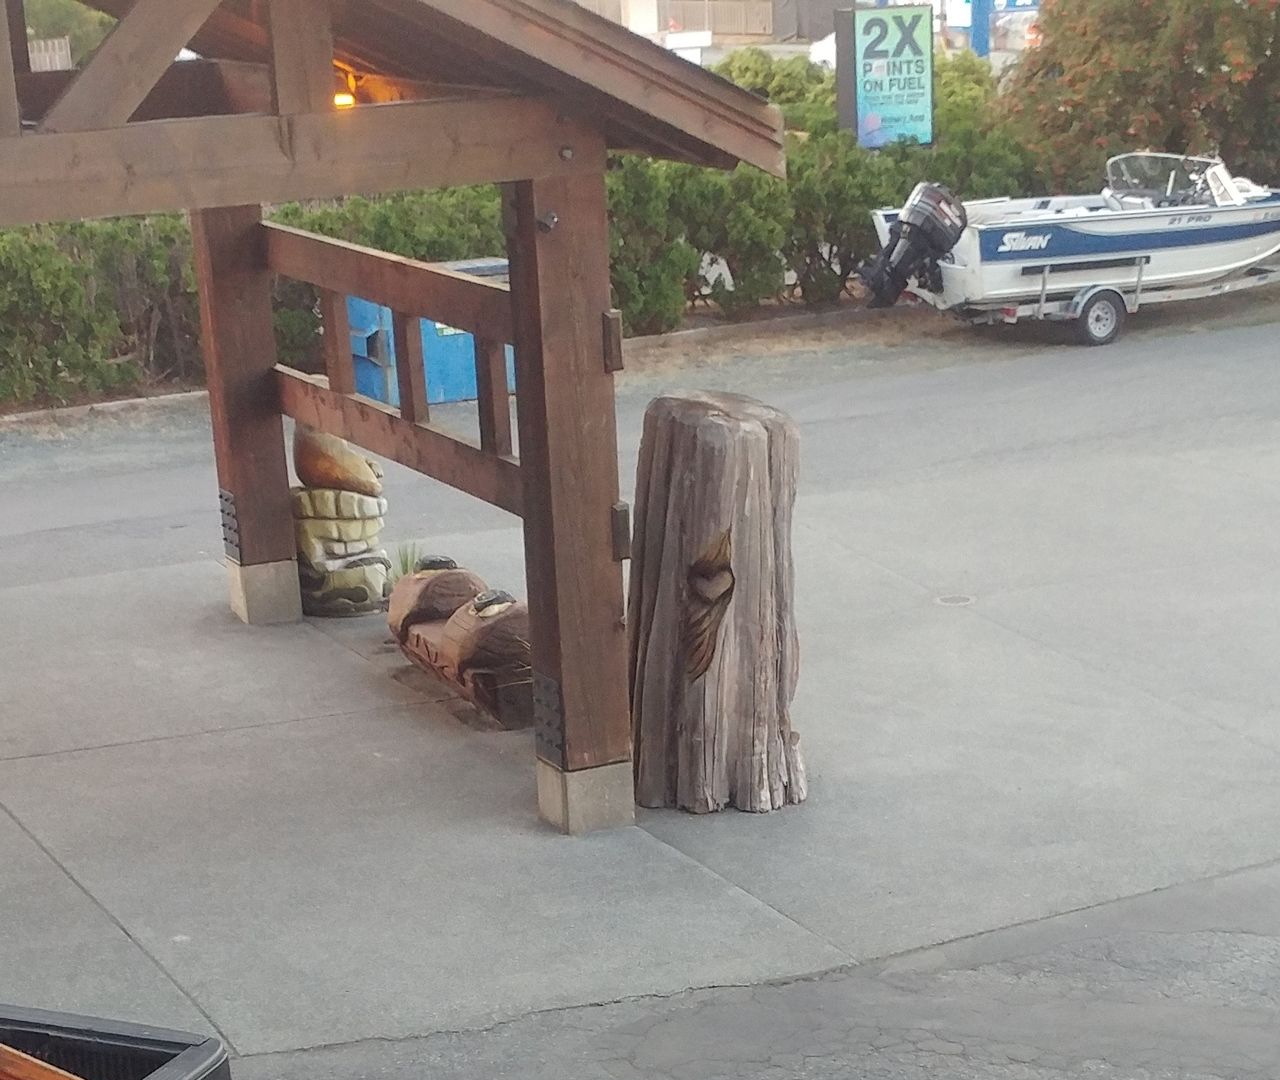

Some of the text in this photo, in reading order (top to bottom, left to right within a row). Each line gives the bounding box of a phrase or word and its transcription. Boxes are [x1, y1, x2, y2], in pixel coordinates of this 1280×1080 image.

[863, 14, 923, 58] 2X
[863, 77, 925, 93] ON FUEL
